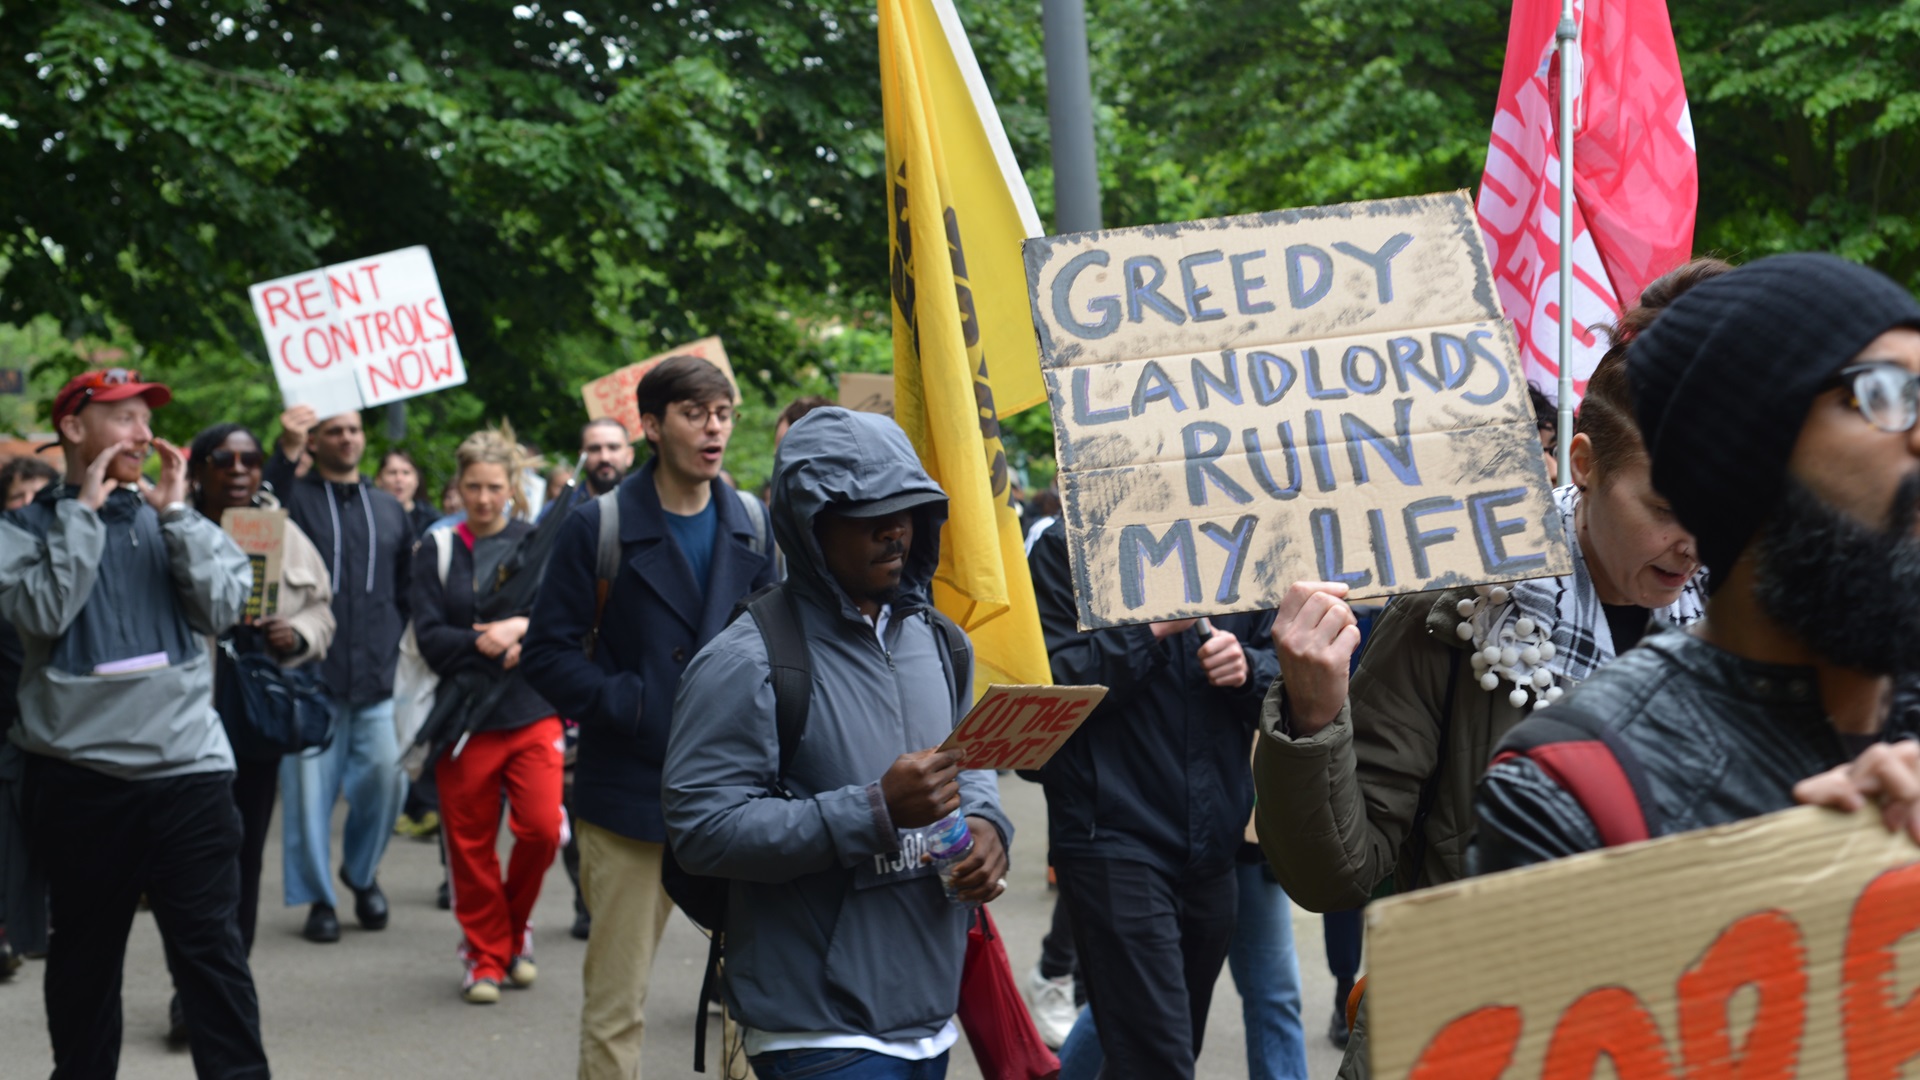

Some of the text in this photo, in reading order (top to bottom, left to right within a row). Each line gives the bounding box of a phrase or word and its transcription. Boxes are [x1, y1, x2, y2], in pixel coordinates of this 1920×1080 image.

[261, 264, 380, 328] RENT
[1051, 232, 1414, 340] GREEDY
[280, 297, 454, 374] CONTROLS
[367, 342, 453, 398] NOW
[1071, 329, 1509, 426] LANDLORDS
[1182, 398, 1422, 506] RUIN
[1119, 486, 1546, 610] MY LIFE
[956, 692, 1089, 742] CUT THE
[956, 734, 1058, 769] RENT!
